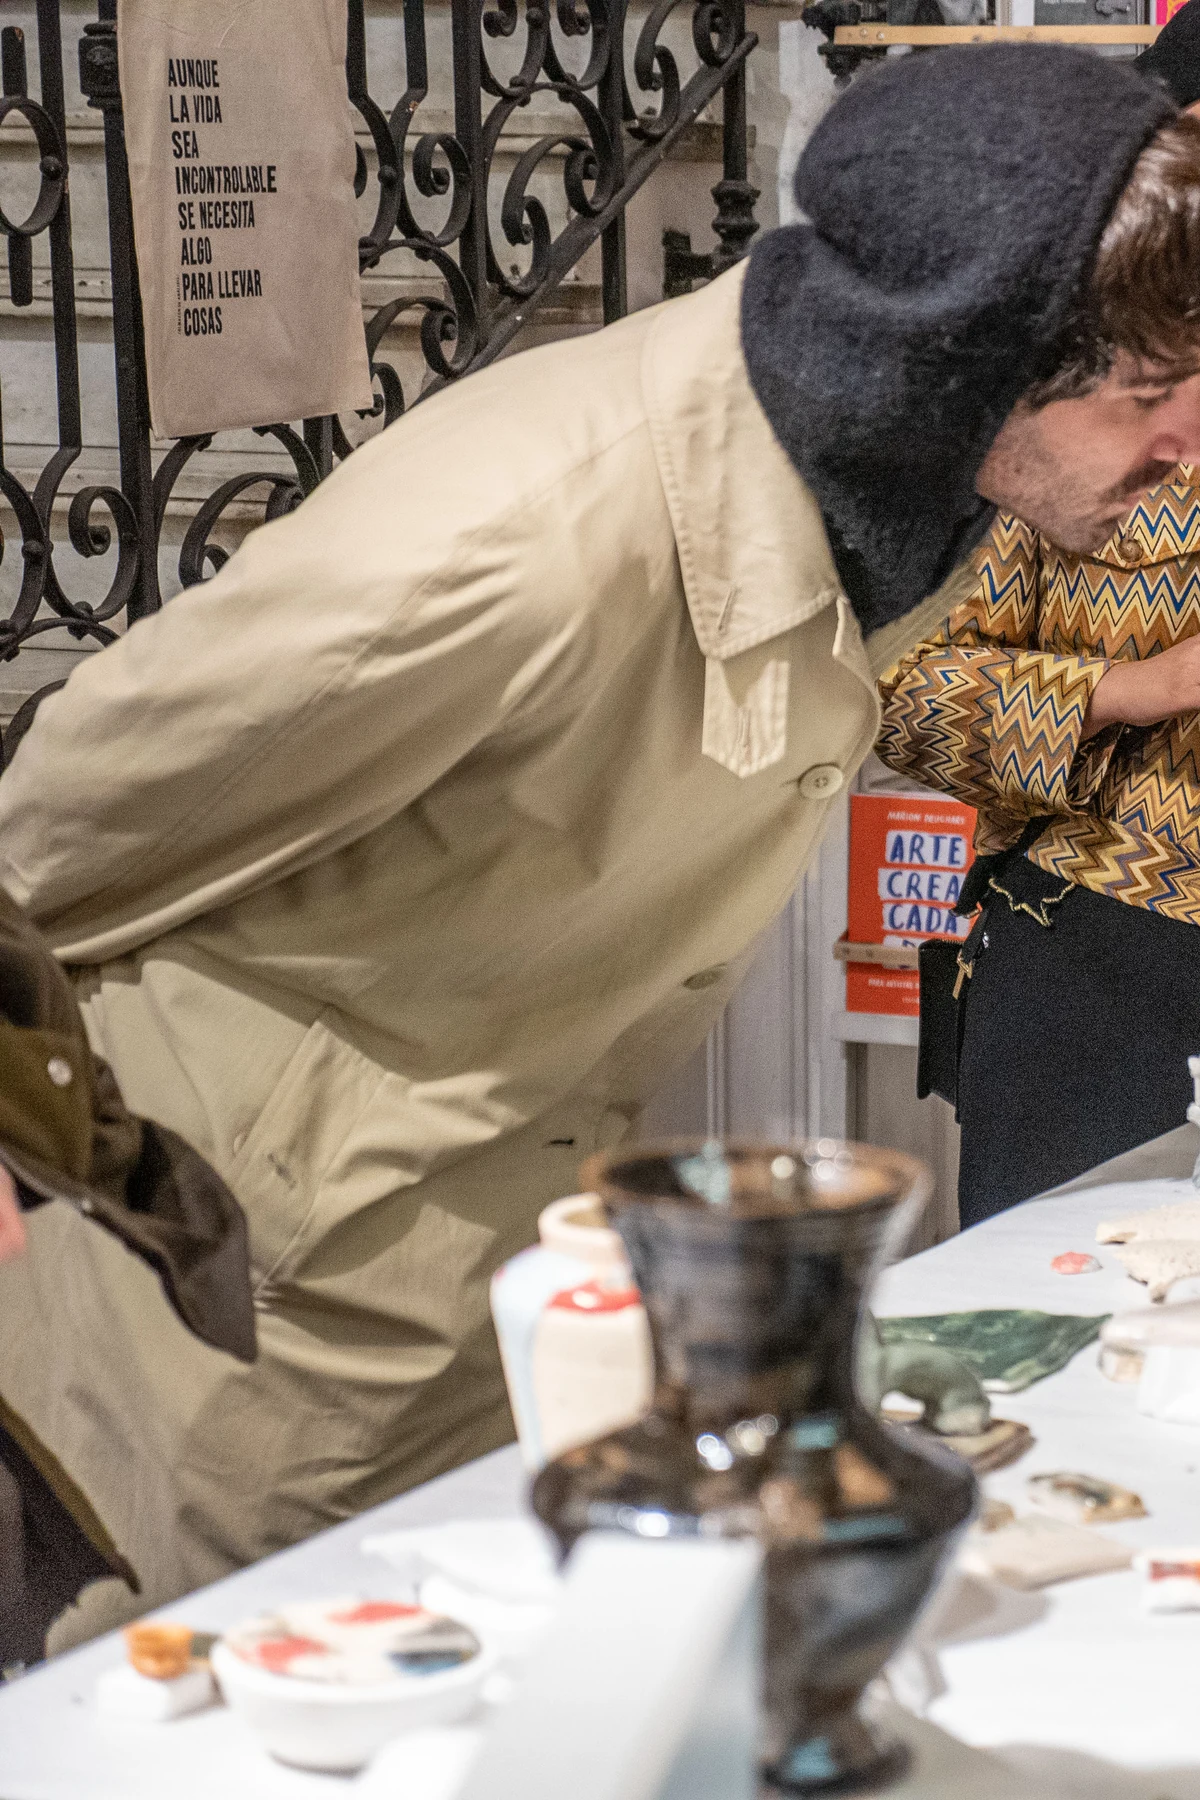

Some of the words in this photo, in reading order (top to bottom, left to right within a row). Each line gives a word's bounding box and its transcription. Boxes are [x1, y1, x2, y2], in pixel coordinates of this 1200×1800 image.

[168, 59, 220, 89] AUNQUE
[170, 95, 190, 123] LA
[193, 95, 222, 123] VIDA
[171, 130, 199, 159] SEA
[175, 165, 277, 194] INCONTROLABLE
[178, 202, 196, 230] SE
[199, 200, 255, 229] NECESITA
[181, 236, 212, 265] ALGO
[182, 272, 214, 301] PARA
[218, 269, 262, 298] LLEVAR
[184, 306, 222, 336] COSAS
[889, 834, 963, 865] ARTE
[887, 871, 959, 904] CREA
[888, 904, 958, 934] CADA
